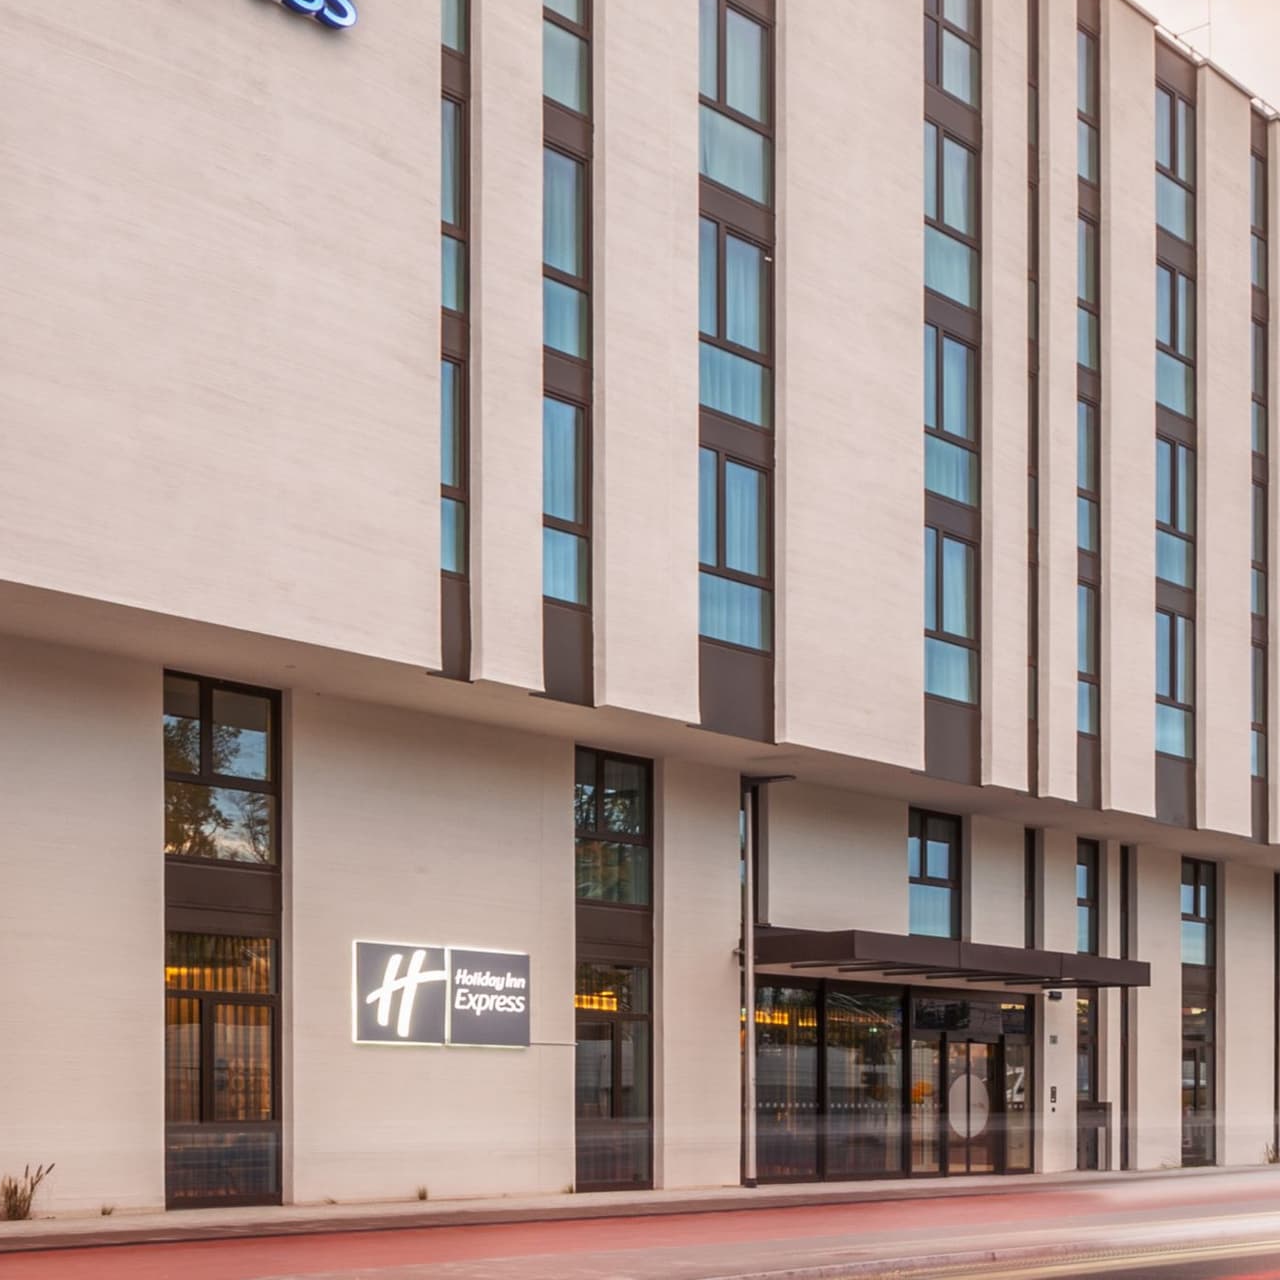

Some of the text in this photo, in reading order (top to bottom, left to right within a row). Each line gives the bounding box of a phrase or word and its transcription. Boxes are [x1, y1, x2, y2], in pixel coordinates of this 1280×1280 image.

[365, 950, 448, 1037] H
[455, 968, 526, 991] Holiday Inn
[454, 988, 526, 1016] Express
